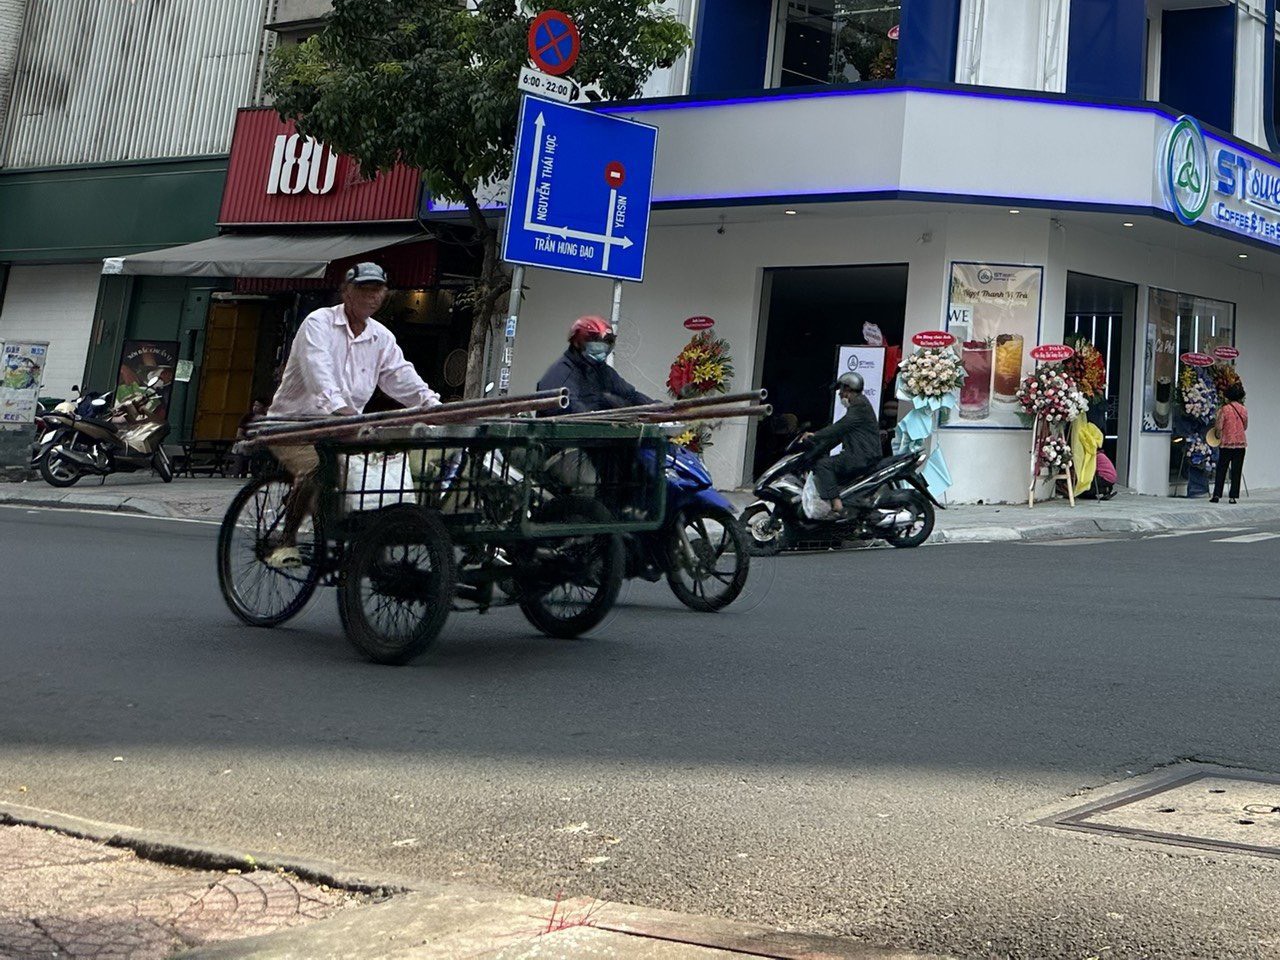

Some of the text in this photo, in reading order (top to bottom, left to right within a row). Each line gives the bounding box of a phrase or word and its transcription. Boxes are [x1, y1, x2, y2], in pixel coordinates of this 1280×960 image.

[523, 73, 541, 88] 6:00
[546, 81, 568, 96] 22:00
[266, 133, 339, 194] 180
[536, 134, 558, 221] NGUYỄN THÁI HỌC
[615, 195, 628, 229] YERSIN
[535, 234, 556, 253] TRẦN
[579, 245, 595, 260] ĐẠO
